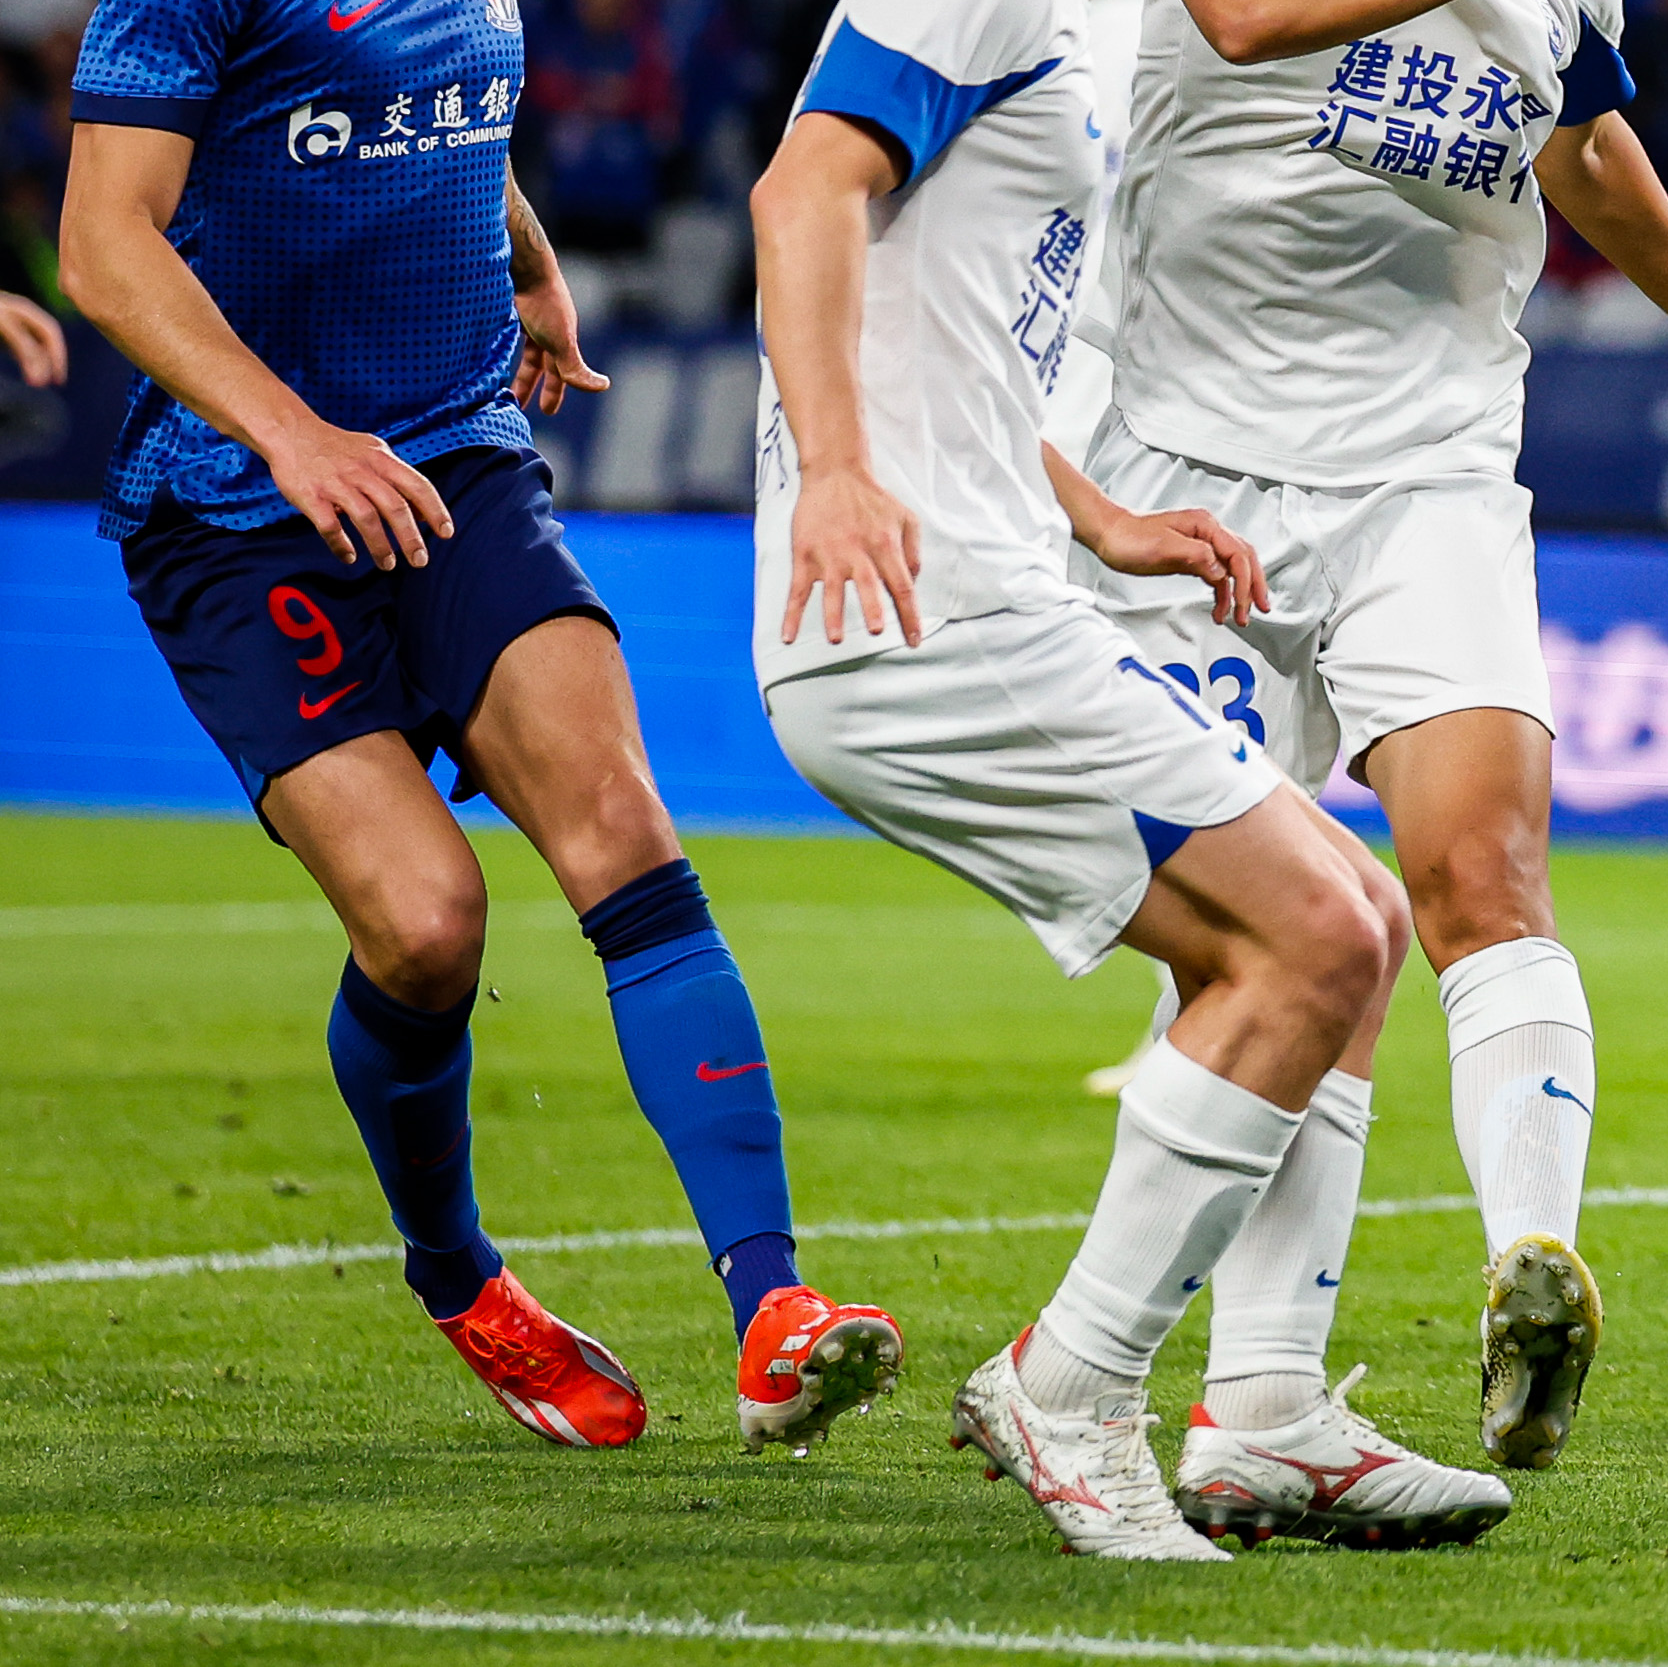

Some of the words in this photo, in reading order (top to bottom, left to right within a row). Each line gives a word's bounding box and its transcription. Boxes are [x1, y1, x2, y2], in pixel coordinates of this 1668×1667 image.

[379, 76, 525, 137] 交通銀
[359, 140, 410, 160] BANK
[417, 136, 440, 152] OF
[268, 585, 344, 677] 9
